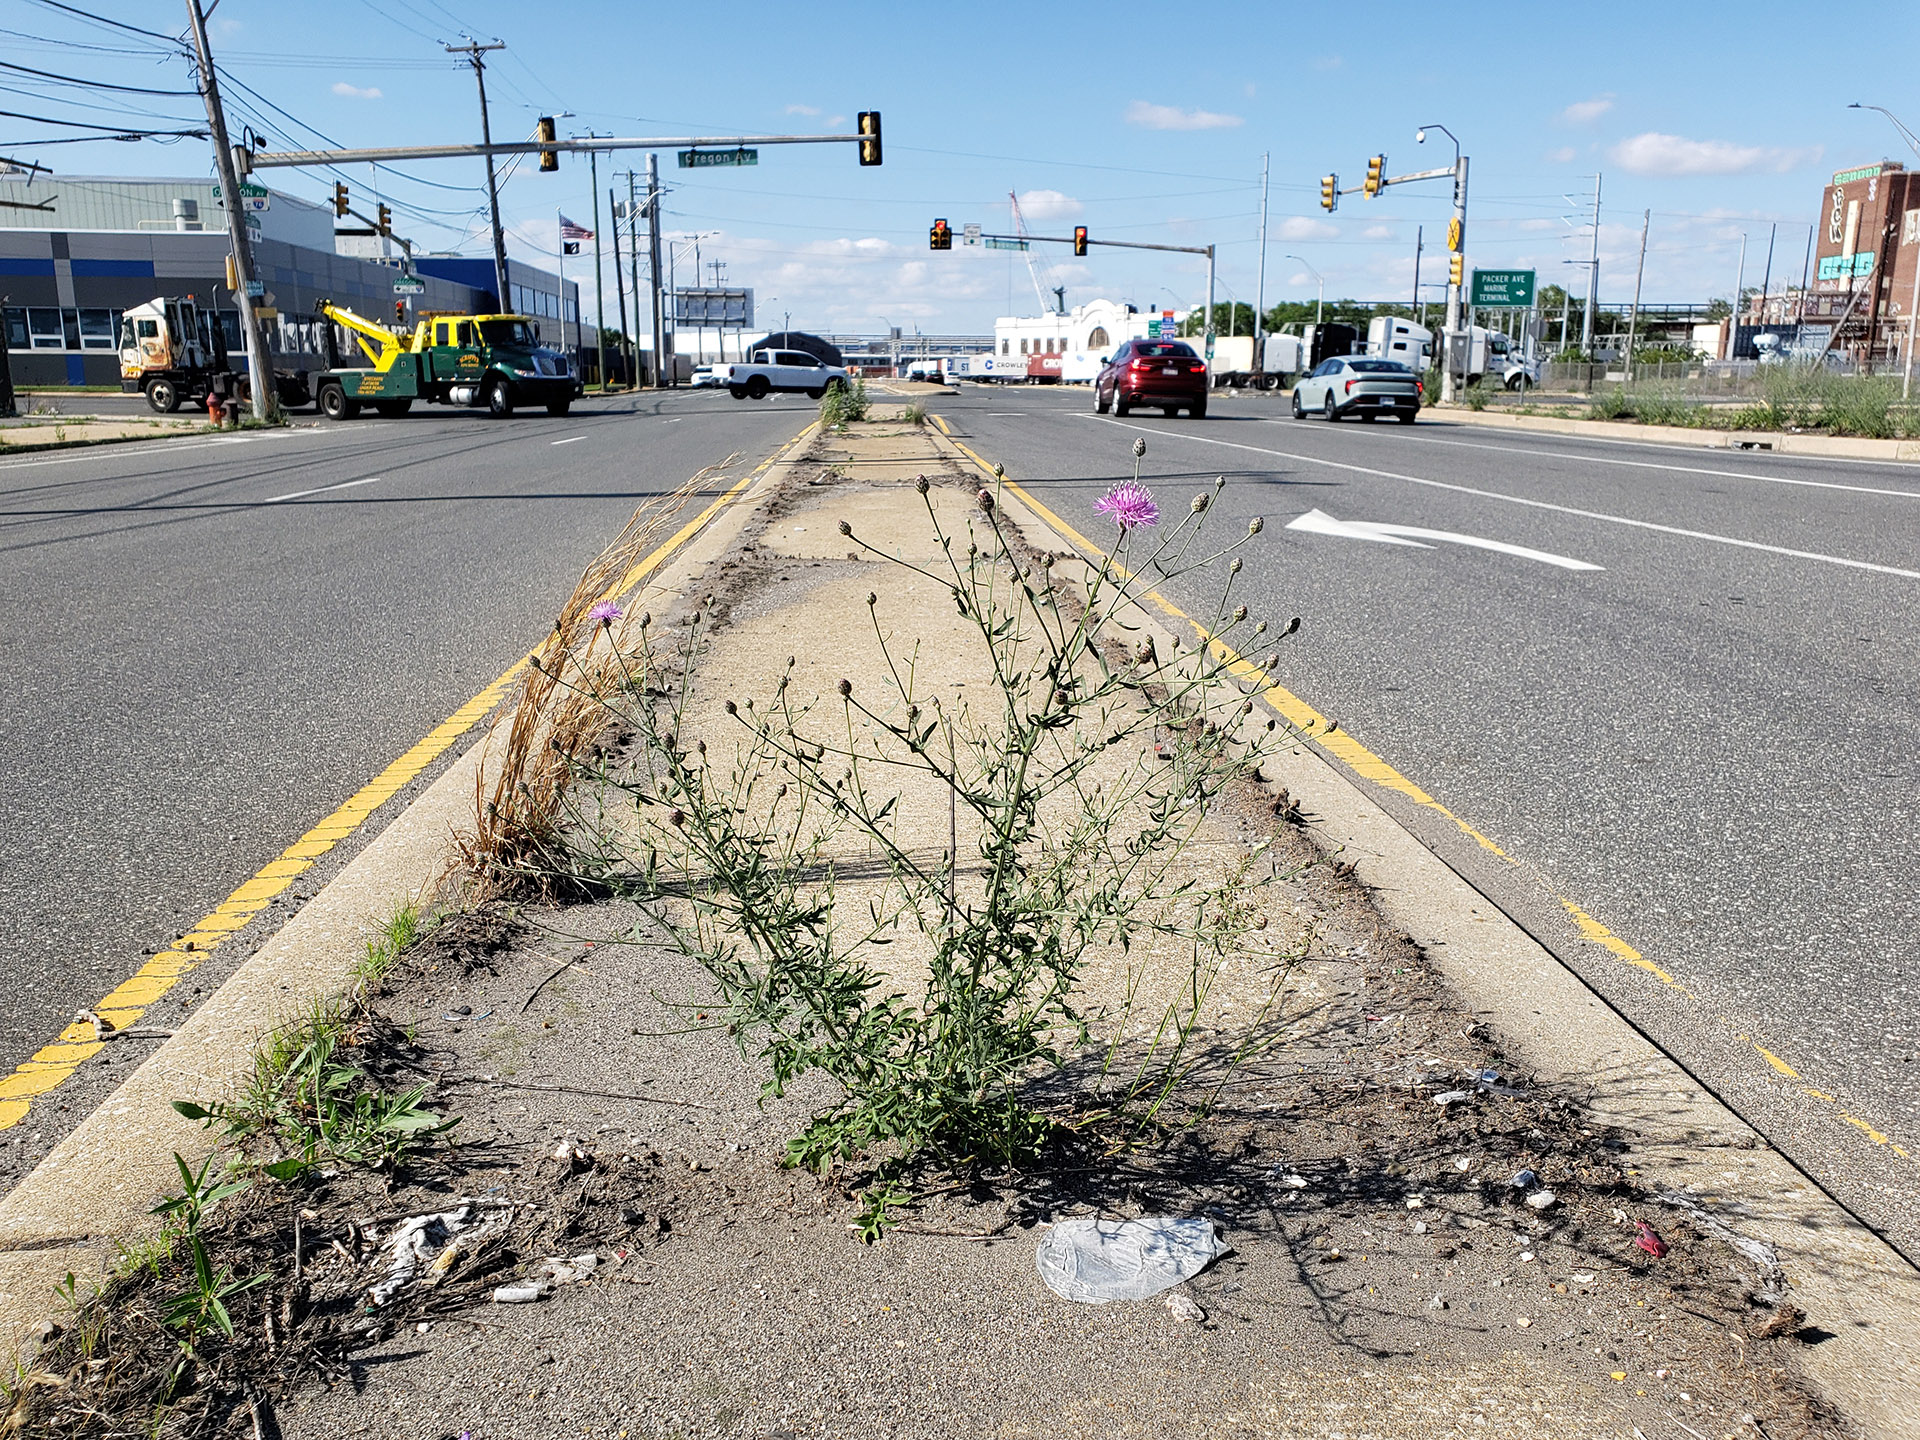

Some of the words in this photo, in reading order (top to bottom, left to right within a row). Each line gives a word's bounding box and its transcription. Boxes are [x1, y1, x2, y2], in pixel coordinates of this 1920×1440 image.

[684, 153, 730, 165] Oregon
[735, 151, 752, 162] Av
[1482, 275, 1509, 283] PACKER
[1512, 275, 1526, 283] AVE
[1484, 284, 1508, 292] MARINE
[1480, 293, 1510, 302] TERMINAL
